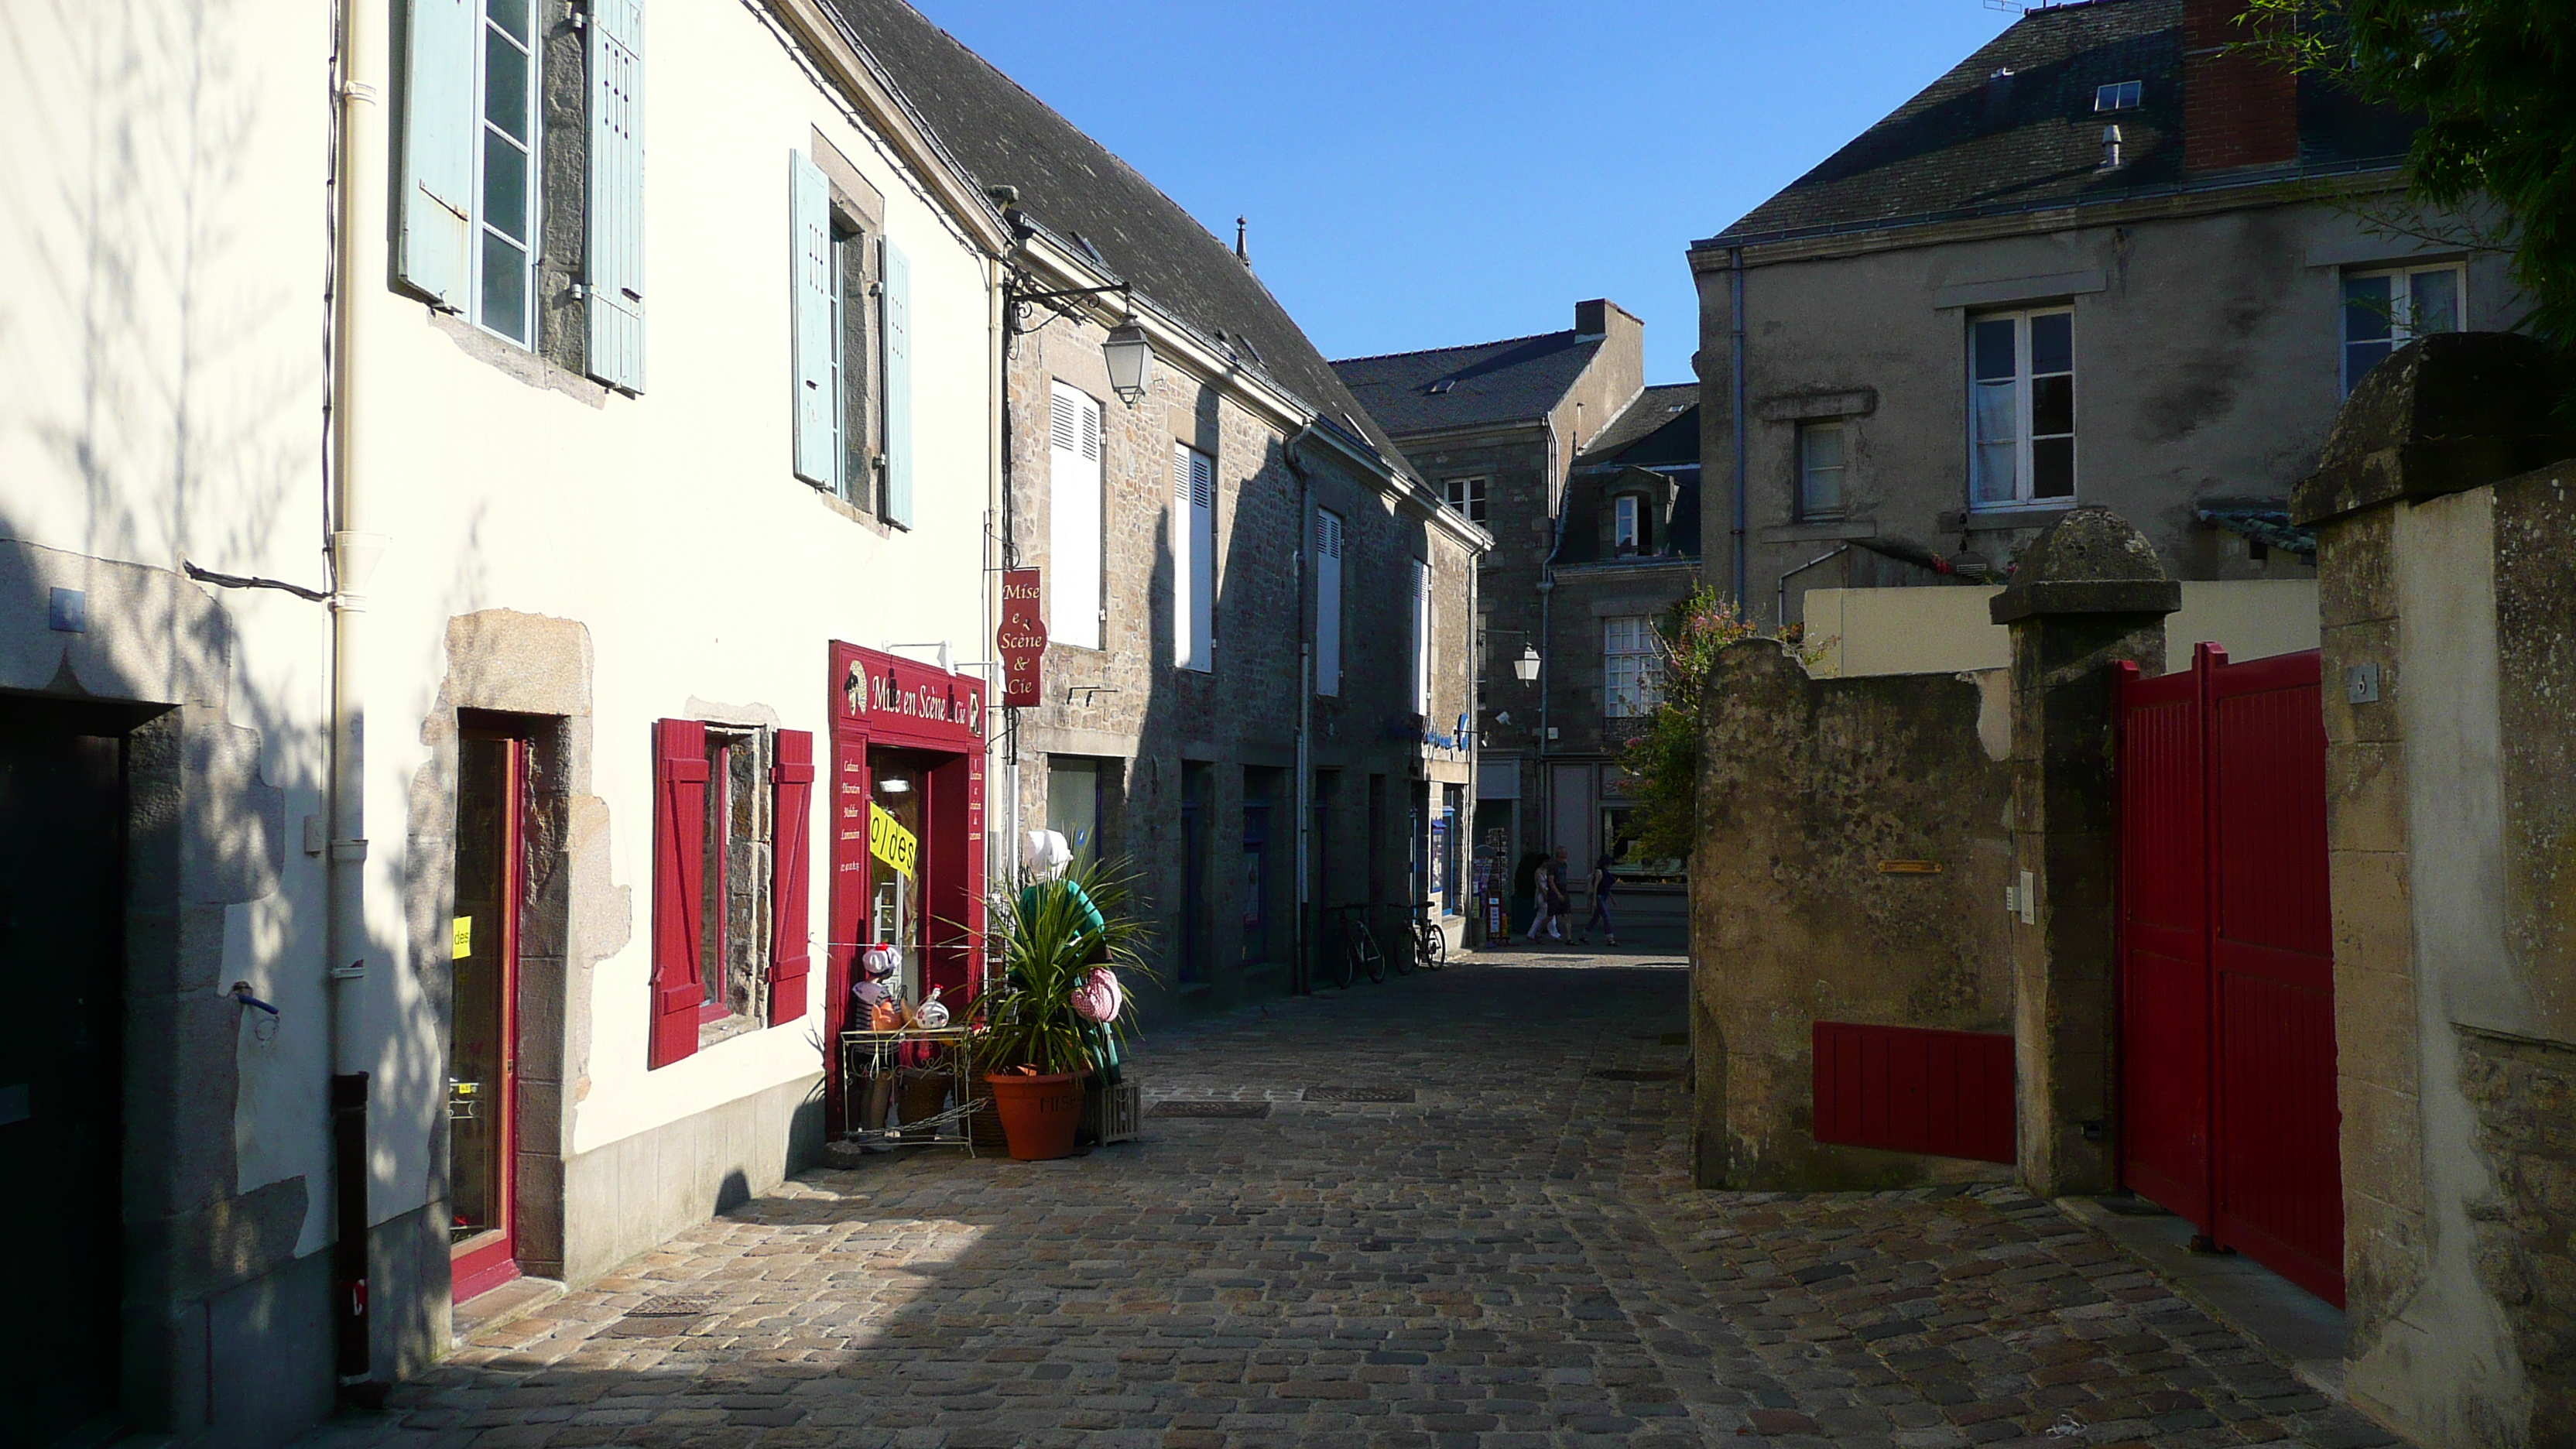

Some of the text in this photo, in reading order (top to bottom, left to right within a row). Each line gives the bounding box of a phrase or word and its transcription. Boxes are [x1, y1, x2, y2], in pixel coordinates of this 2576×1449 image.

[1003, 583, 1040, 600] Mise
[1001, 632, 1042, 649] Scène
[1013, 656, 1030, 671] &
[1009, 678, 1033, 695] Cie
[903, 690, 916, 717] en
[919, 684, 946, 721] Scène
[955, 701, 967, 725] Cie
